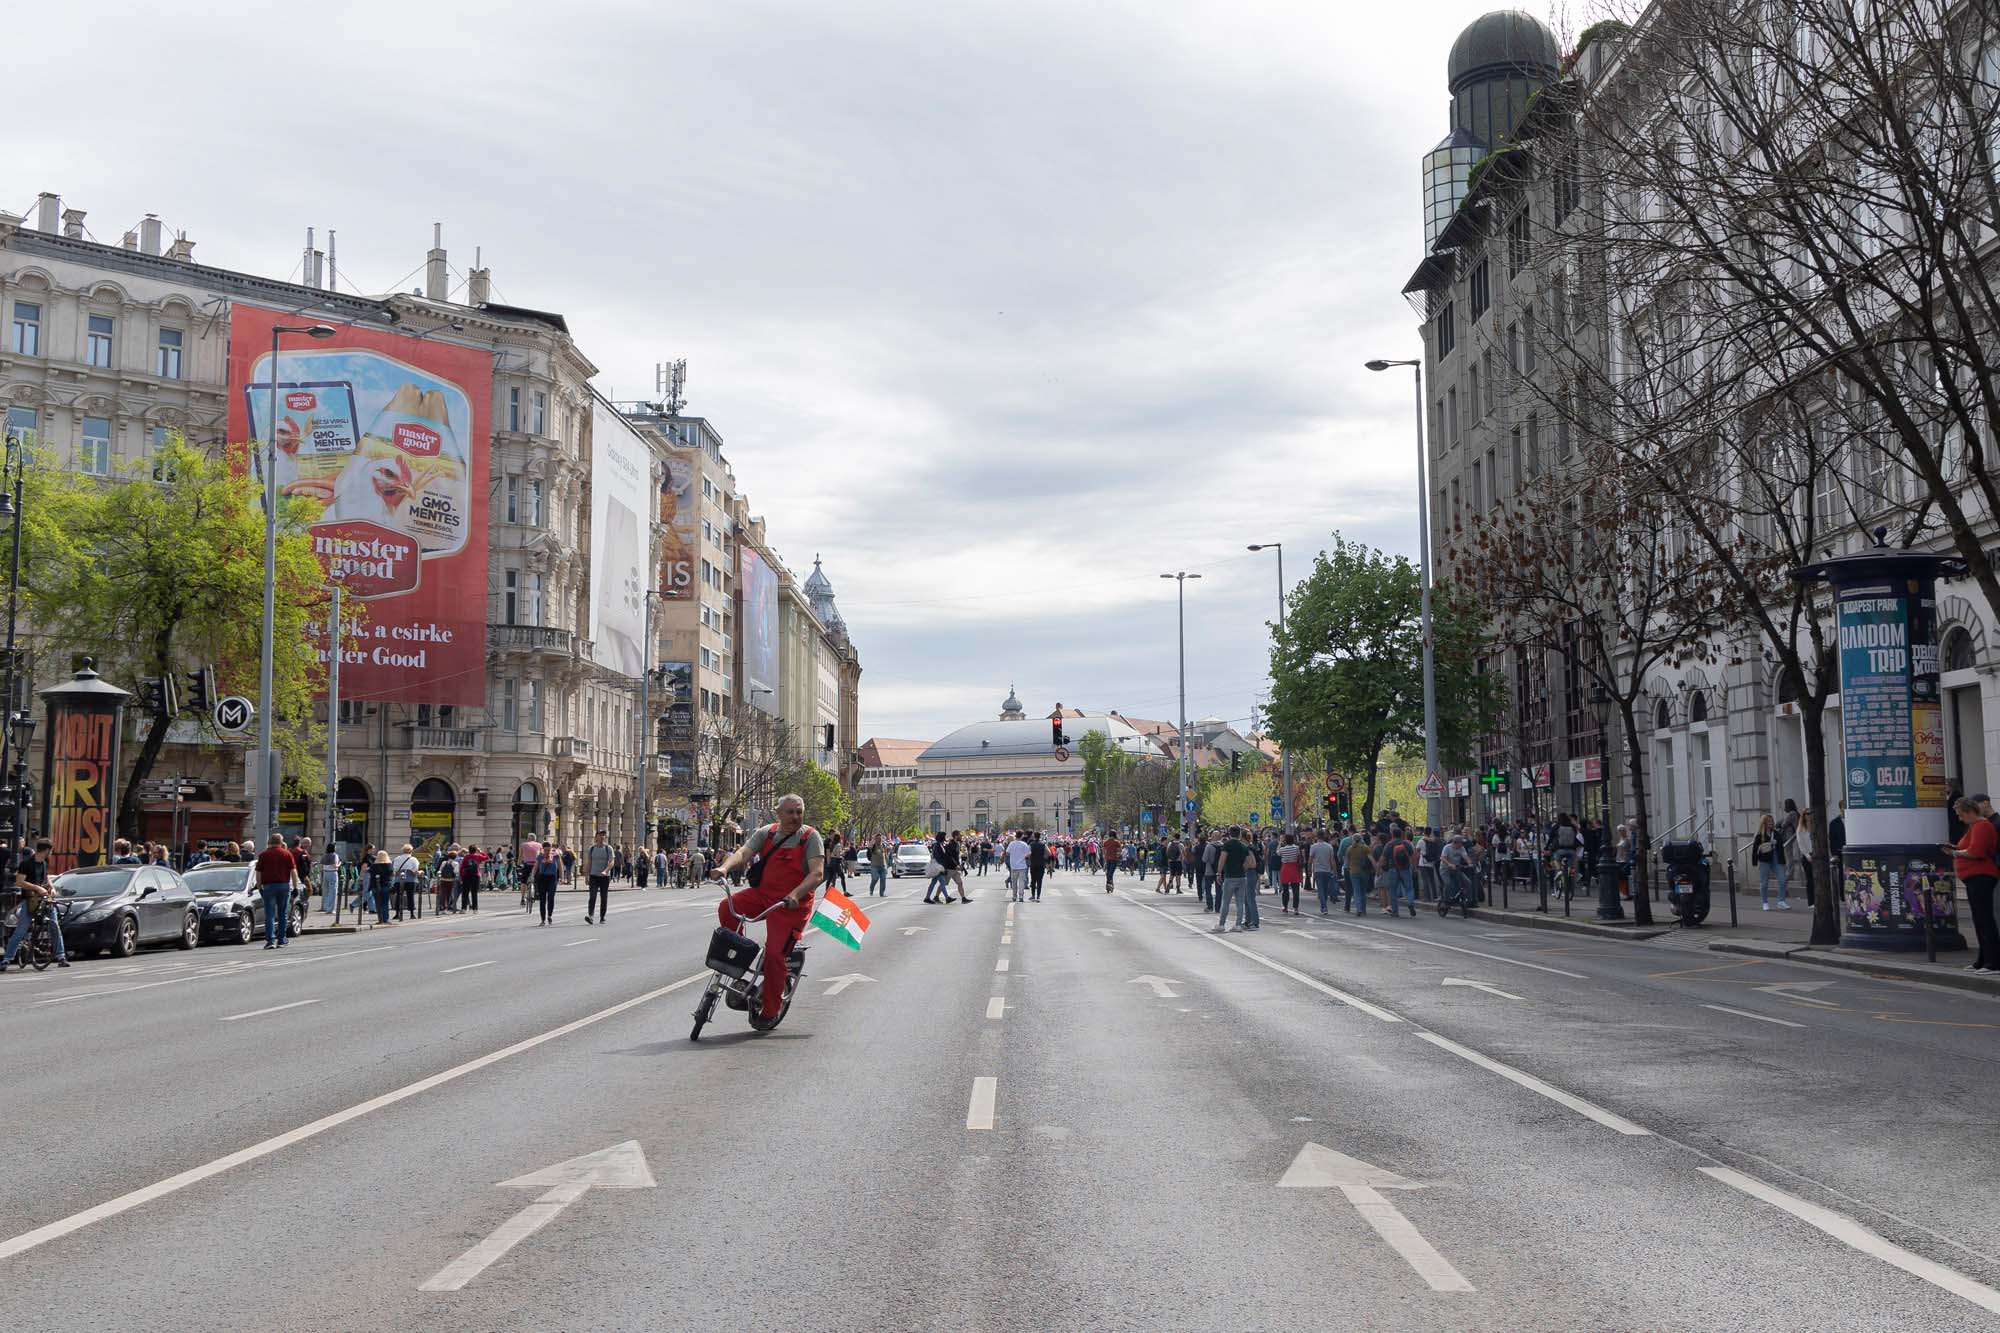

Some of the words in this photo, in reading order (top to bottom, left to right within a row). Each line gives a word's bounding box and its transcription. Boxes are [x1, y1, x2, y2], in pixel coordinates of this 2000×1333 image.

[314, 437, 352, 448] MENTES
[398, 427, 438, 444] master
[403, 436, 431, 450] good
[409, 505, 460, 527] MENTES
[315, 537, 409, 562] master
[329, 557, 395, 581] good
[1877, 598, 1898, 611] PARK
[374, 625, 387, 639] a
[391, 622, 453, 643] csirke
[1841, 623, 1905, 650] RANDOM
[372, 646, 426, 669] Good
[52, 760, 111, 807] ART
[1876, 766, 1912, 787] 05.07.
